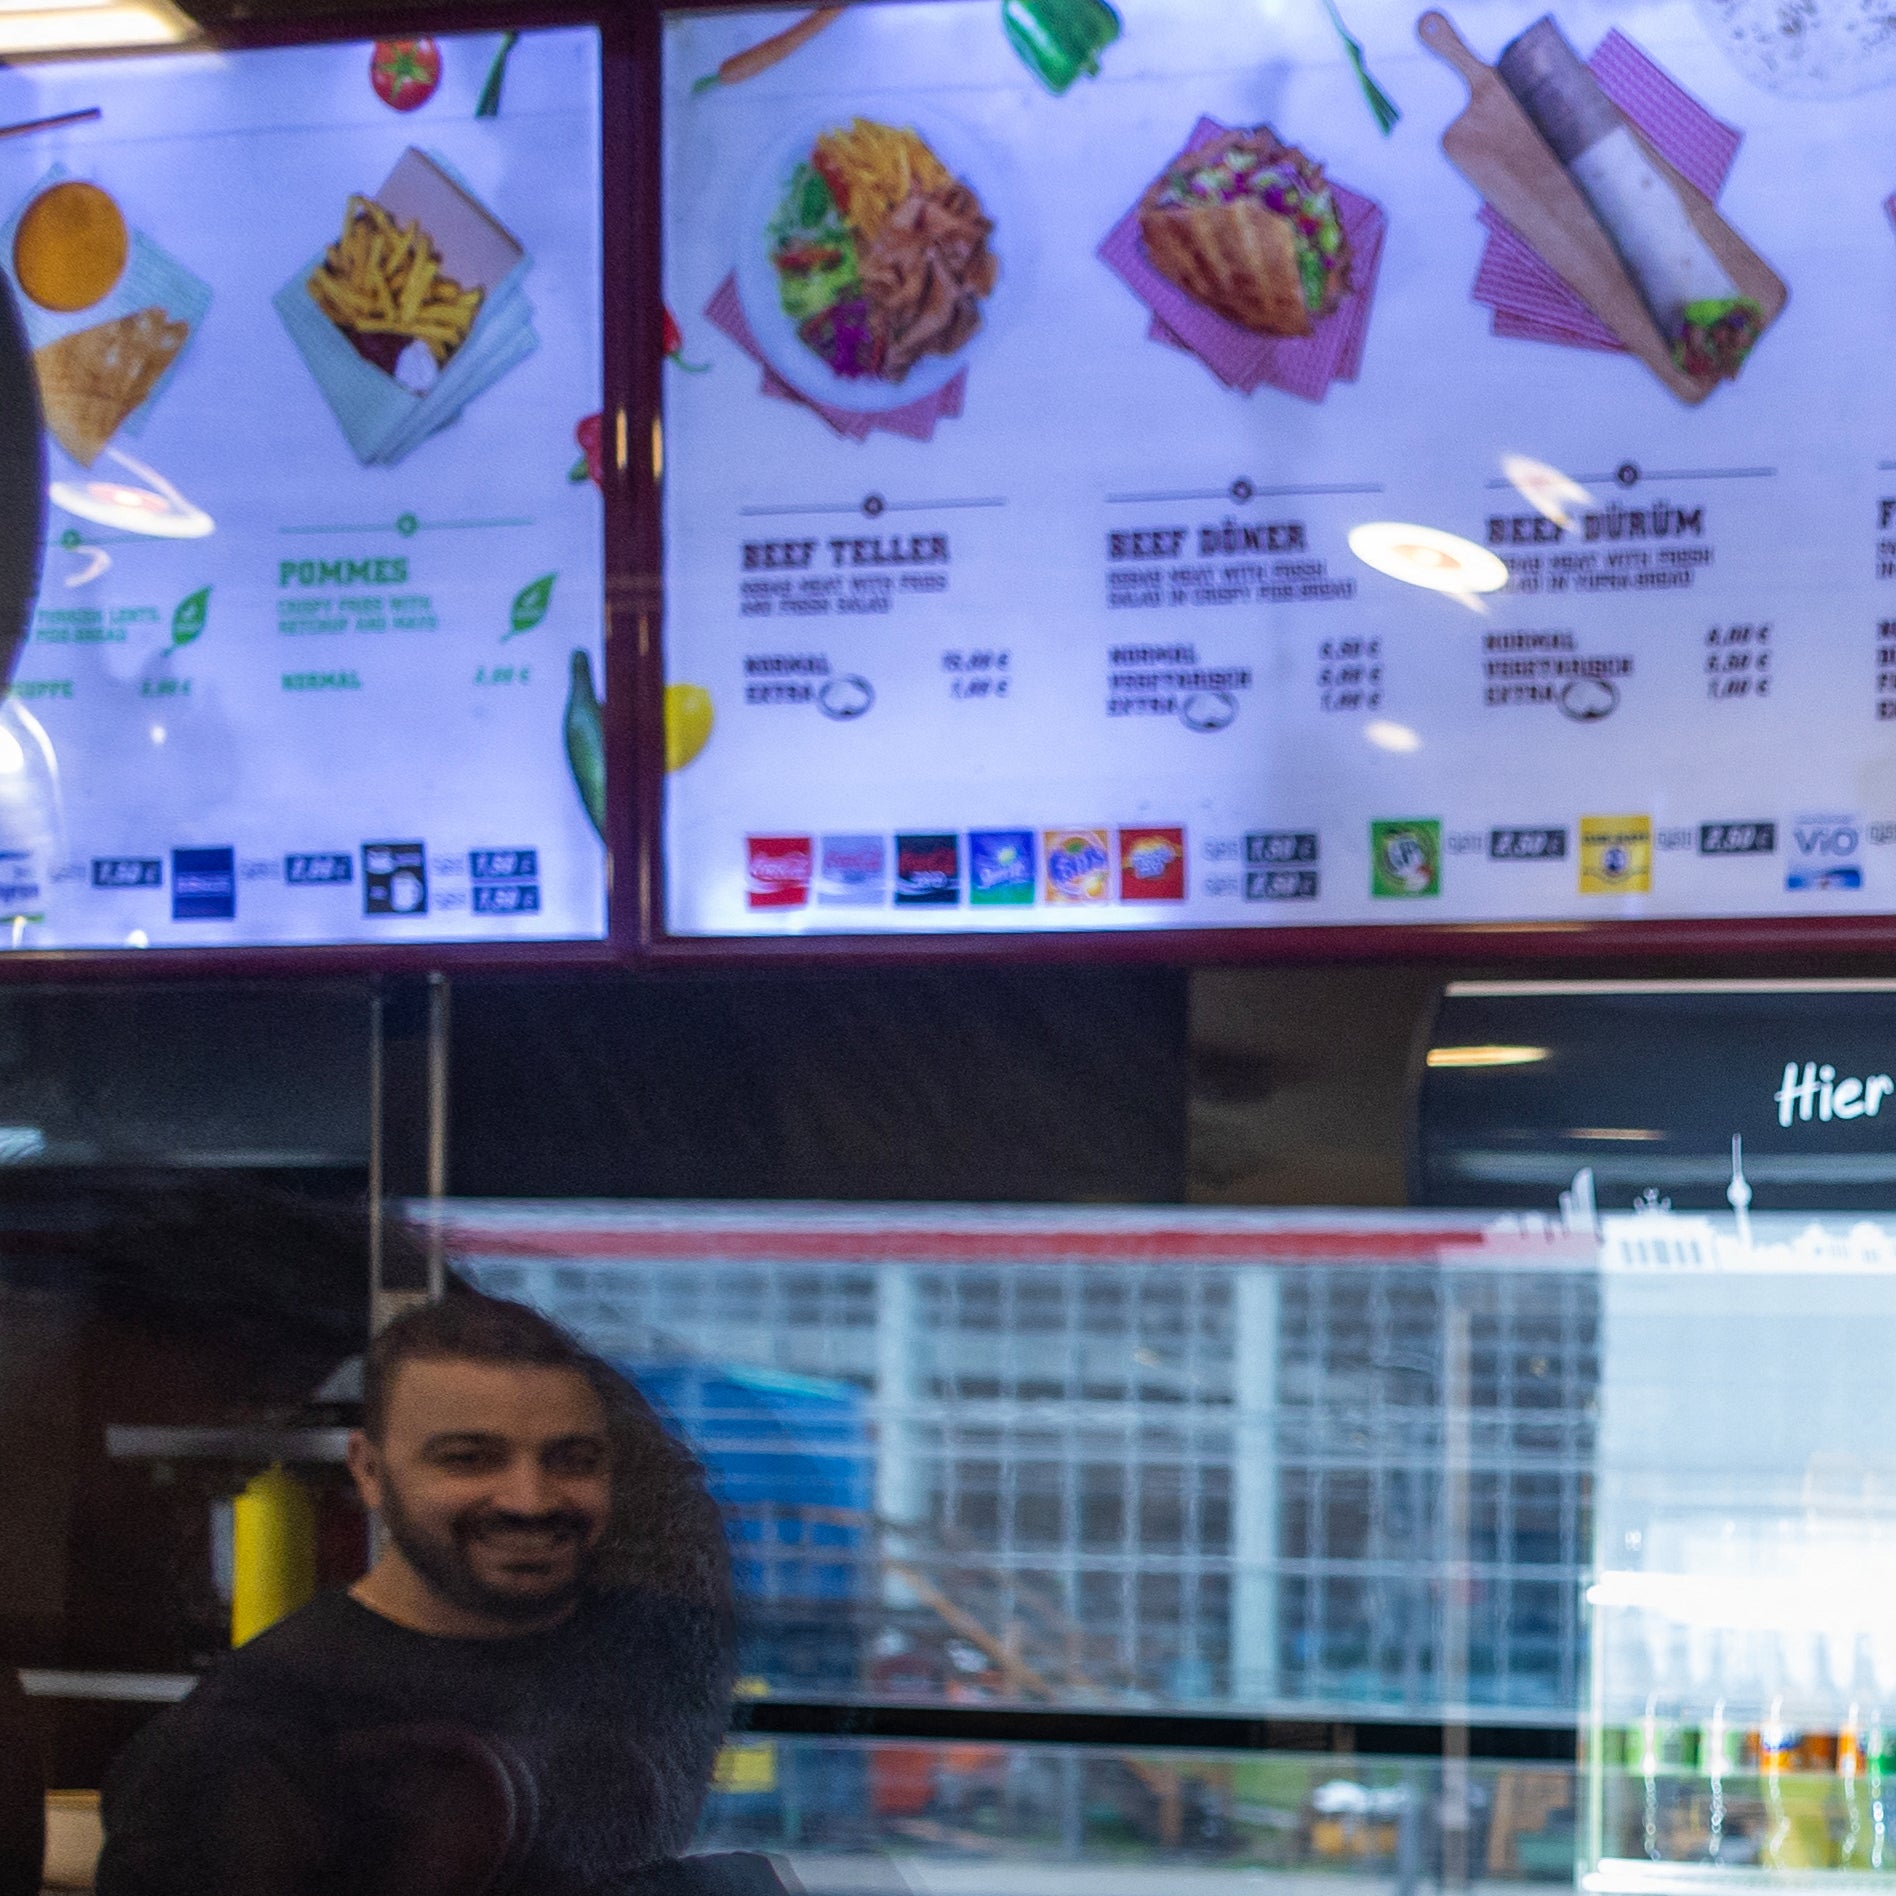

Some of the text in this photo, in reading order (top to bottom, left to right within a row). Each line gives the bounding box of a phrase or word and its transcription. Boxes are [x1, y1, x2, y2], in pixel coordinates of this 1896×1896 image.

[1108, 514, 1306, 561] BEEF DÖNER
[1582, 499, 1704, 542] DÜRÜM
[742, 533, 949, 571] BEEF TELLER
[279, 558, 410, 588] POMMES
[281, 672, 363, 691] NORMAL
[1776, 1061, 1895, 1128] Hier
